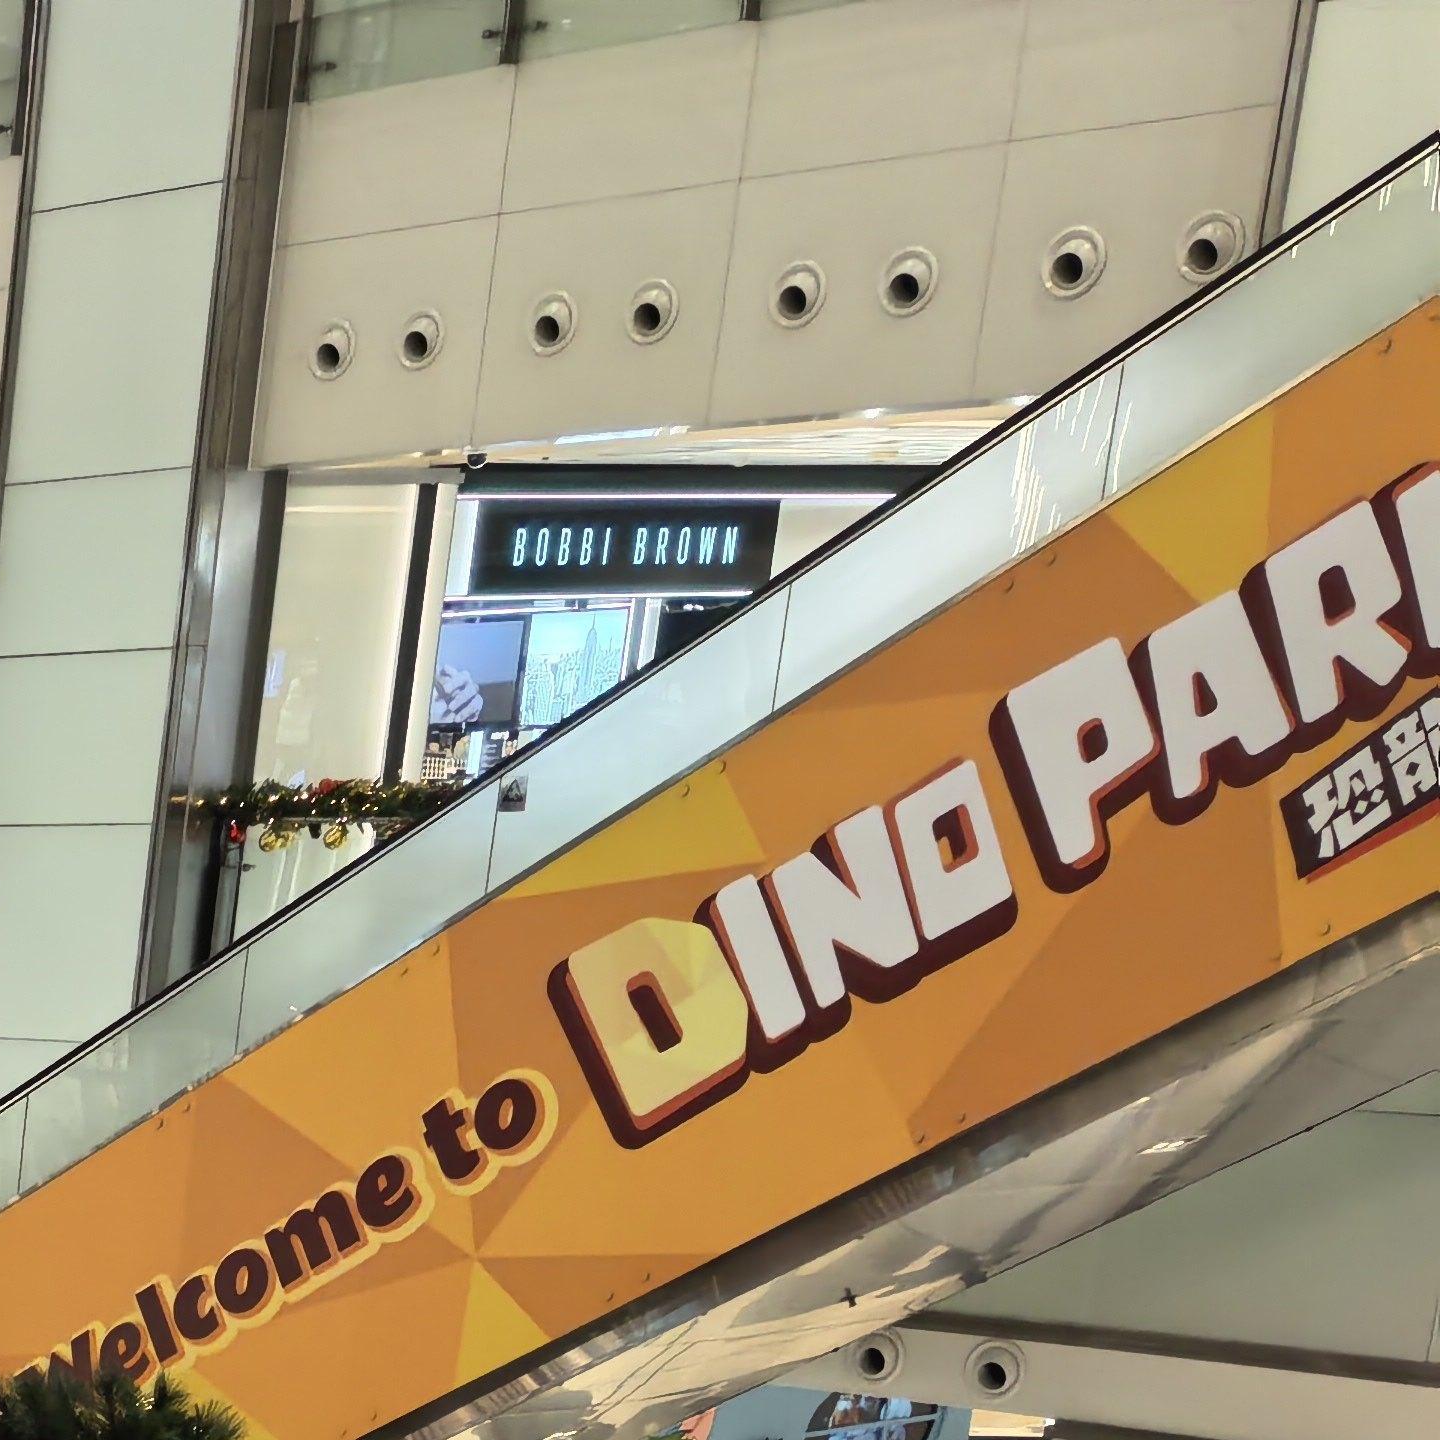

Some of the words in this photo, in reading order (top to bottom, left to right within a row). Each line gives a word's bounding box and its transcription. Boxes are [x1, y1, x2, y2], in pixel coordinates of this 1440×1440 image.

[512, 526, 612, 567] BOBBI
[633, 525, 739, 566] BROWN
[552, 760, 1018, 1138] DINO
[13, 1153, 417, 1386] Welcome
[422, 1078, 538, 1181] to
